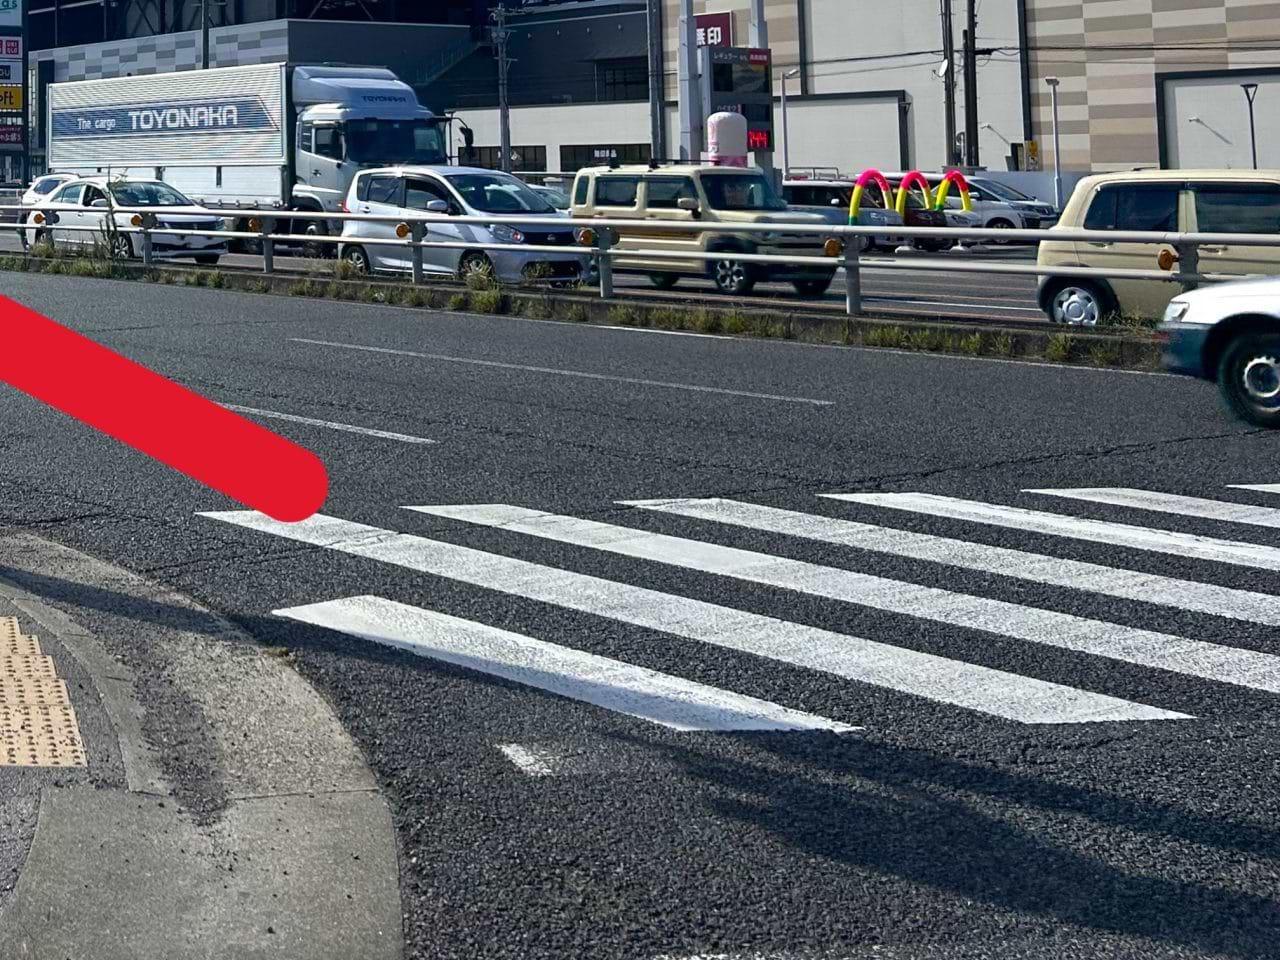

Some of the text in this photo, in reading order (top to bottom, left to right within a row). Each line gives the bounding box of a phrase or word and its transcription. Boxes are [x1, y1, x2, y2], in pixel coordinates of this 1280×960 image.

[77, 105, 238, 131] The cargo TOYONAKA
